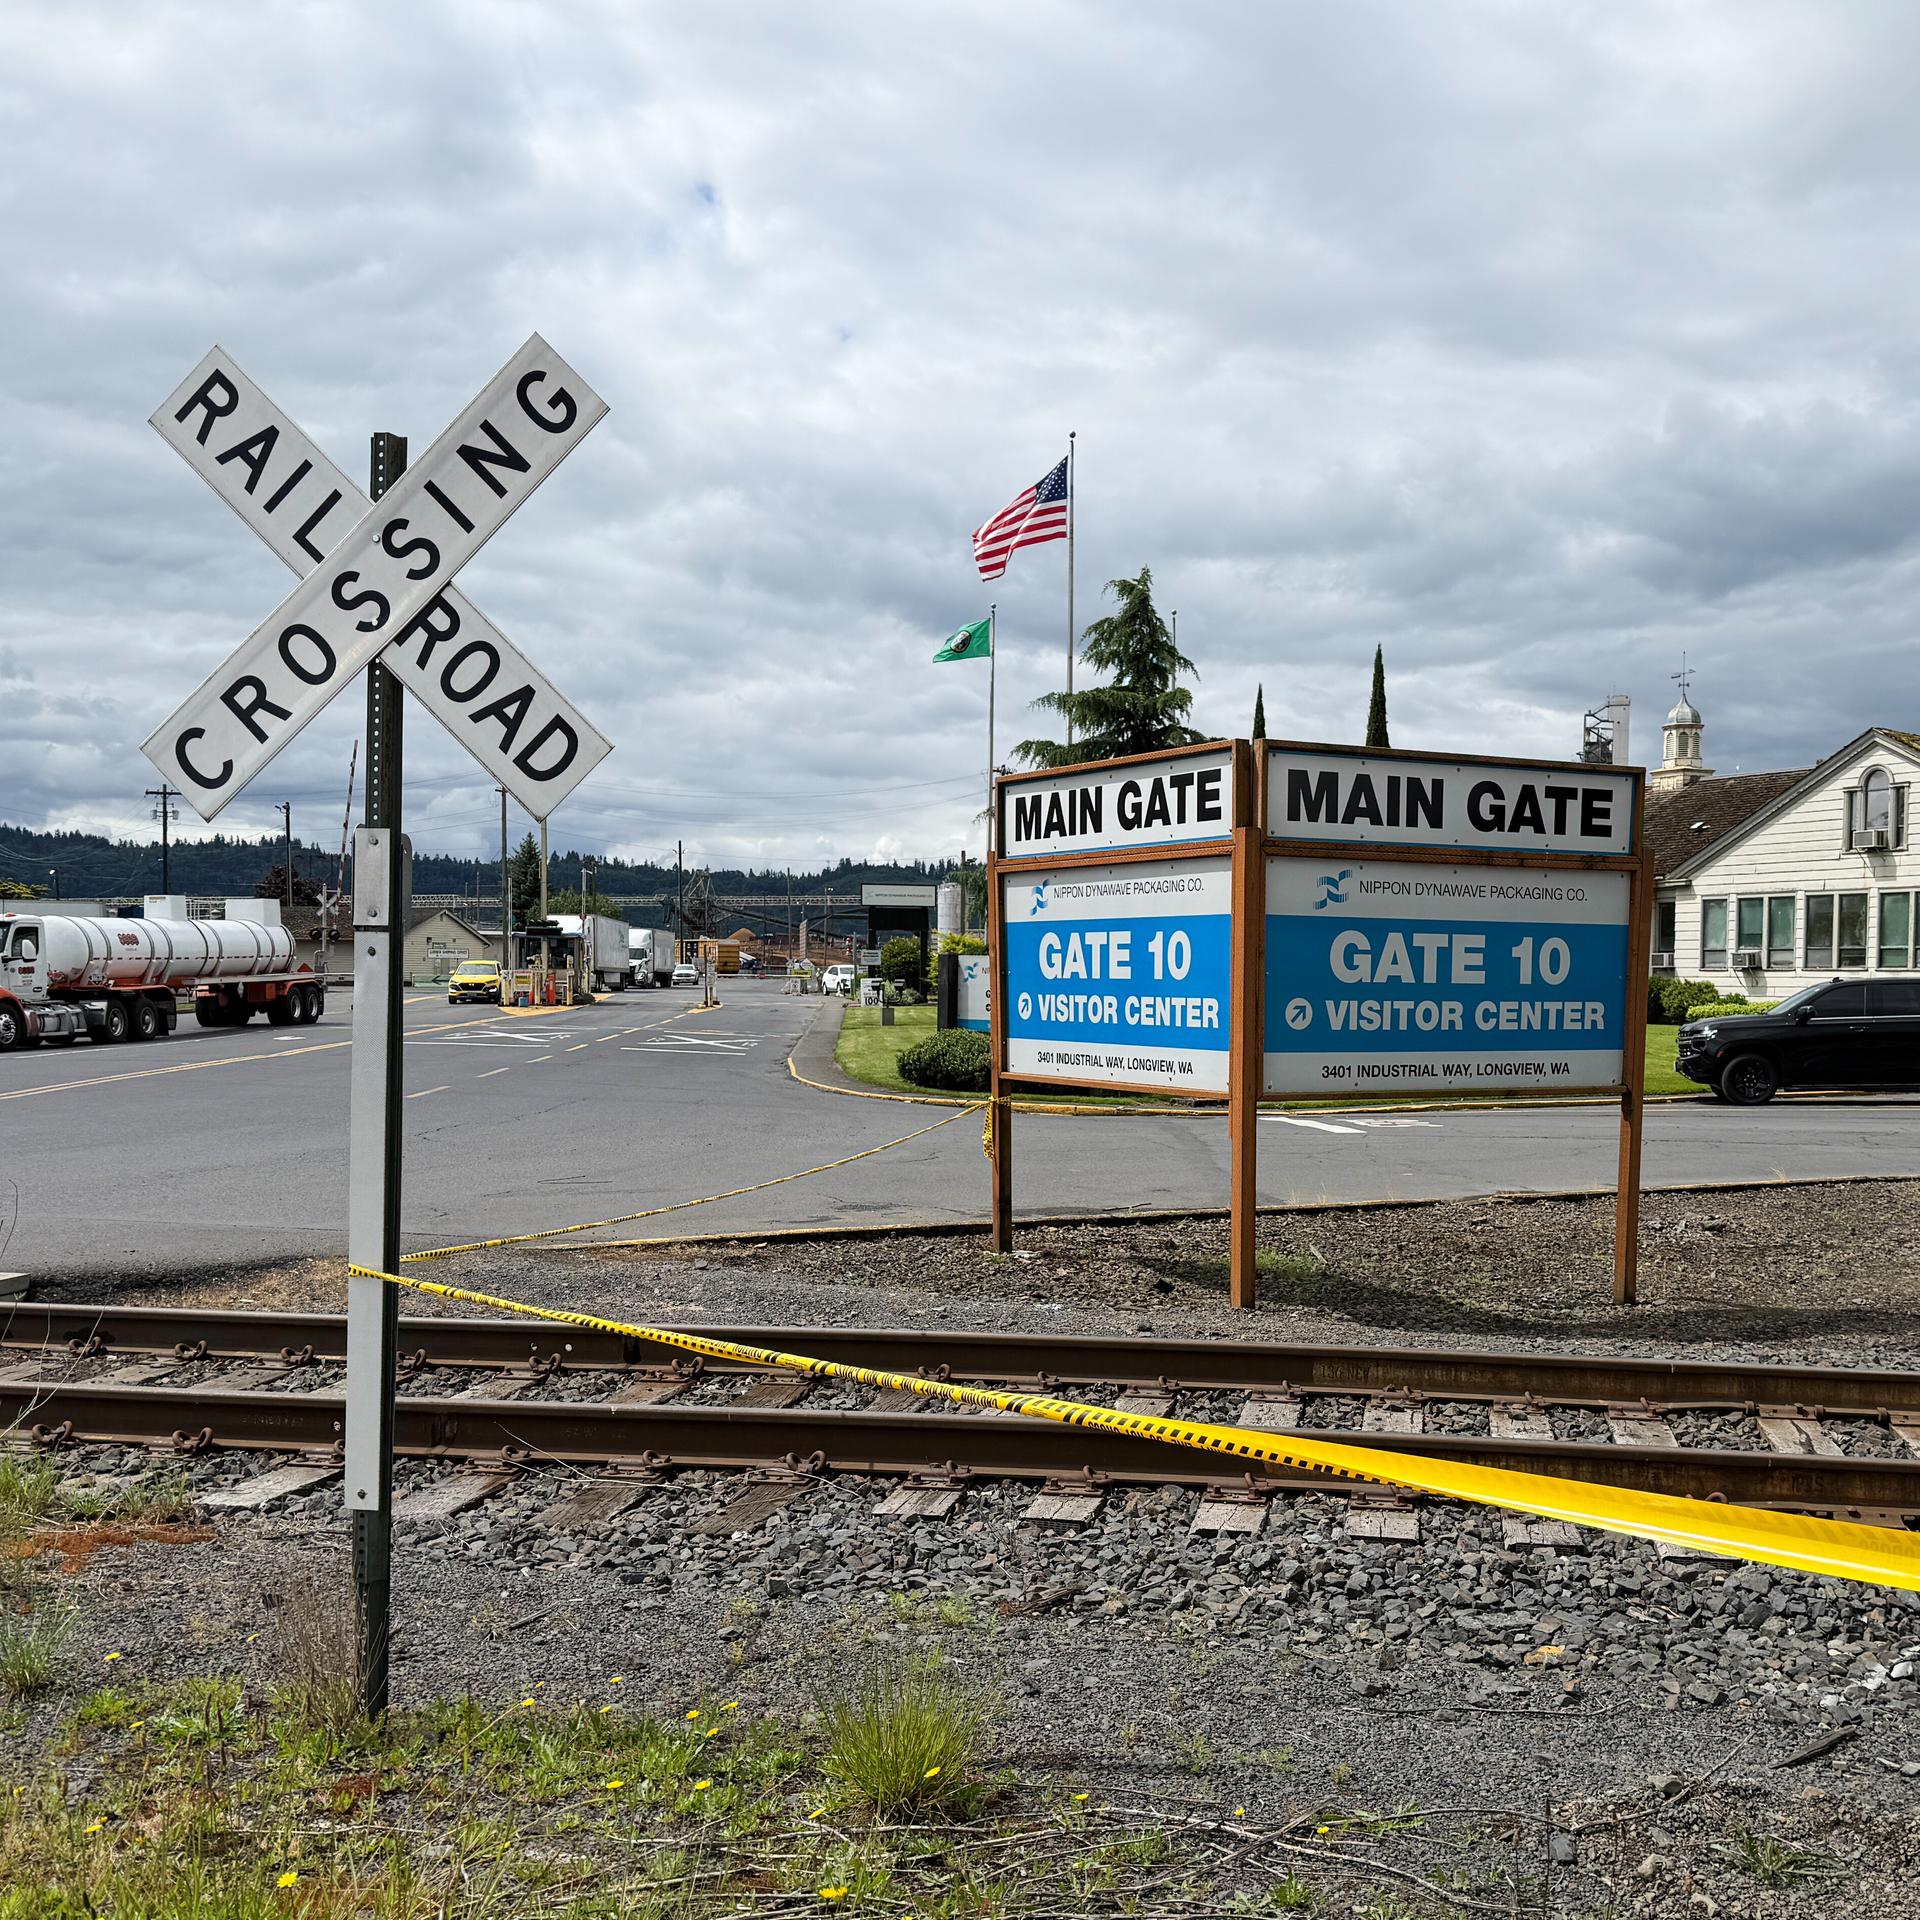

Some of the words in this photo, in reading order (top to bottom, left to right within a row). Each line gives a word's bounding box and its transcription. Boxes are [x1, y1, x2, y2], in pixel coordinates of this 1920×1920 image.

[174, 368, 343, 564] RAIL
[399, 594, 579, 782] ROAD
[175, 370, 578, 790] CROSSING
[1015, 786, 1103, 842] MAIN
[1117, 768, 1222, 831] GATE
[1287, 769, 1444, 829] MAIN
[1467, 781, 1614, 838] GATE
[1053, 885, 1083, 899] NIPPON
[1085, 882, 1132, 898] DYNAWAVE
[1133, 879, 1186, 895] PACKAGING
[1187, 877, 1204, 892] CO.
[1359, 880, 1411, 896] NIPPON
[1415, 882, 1487, 898] DYNAWAVE
[1490, 885, 1563, 901] PACKAGING
[1566, 888, 1588, 902] CO.
[1039, 931, 1132, 980] GATE
[1148, 930, 1192, 981] 10
[1329, 930, 1486, 984] GATE
[1511, 936, 1571, 985] 10
[1037, 993, 1118, 1024] VISITOR
[1124, 995, 1219, 1029] CENTER
[1325, 999, 1464, 1031] VISITOR
[1475, 1000, 1605, 1031] CENTER
[1037, 1051, 1054, 1064] 3401
[1056, 1052, 1104, 1068] INDUSTRIAL
[1105, 1056, 1126, 1072] WAY,
[1127, 1058, 1176, 1075] LONGVIEW,
[1177, 1061, 1194, 1075] WA
[1321, 1065, 1352, 1079] 3401
[1356, 1063, 1439, 1078] INDUSTRIAL
[1441, 1063, 1473, 1079] WAY,
[1476, 1062, 1547, 1078] LONGVIEW,
[1550, 1062, 1570, 1075] WA
